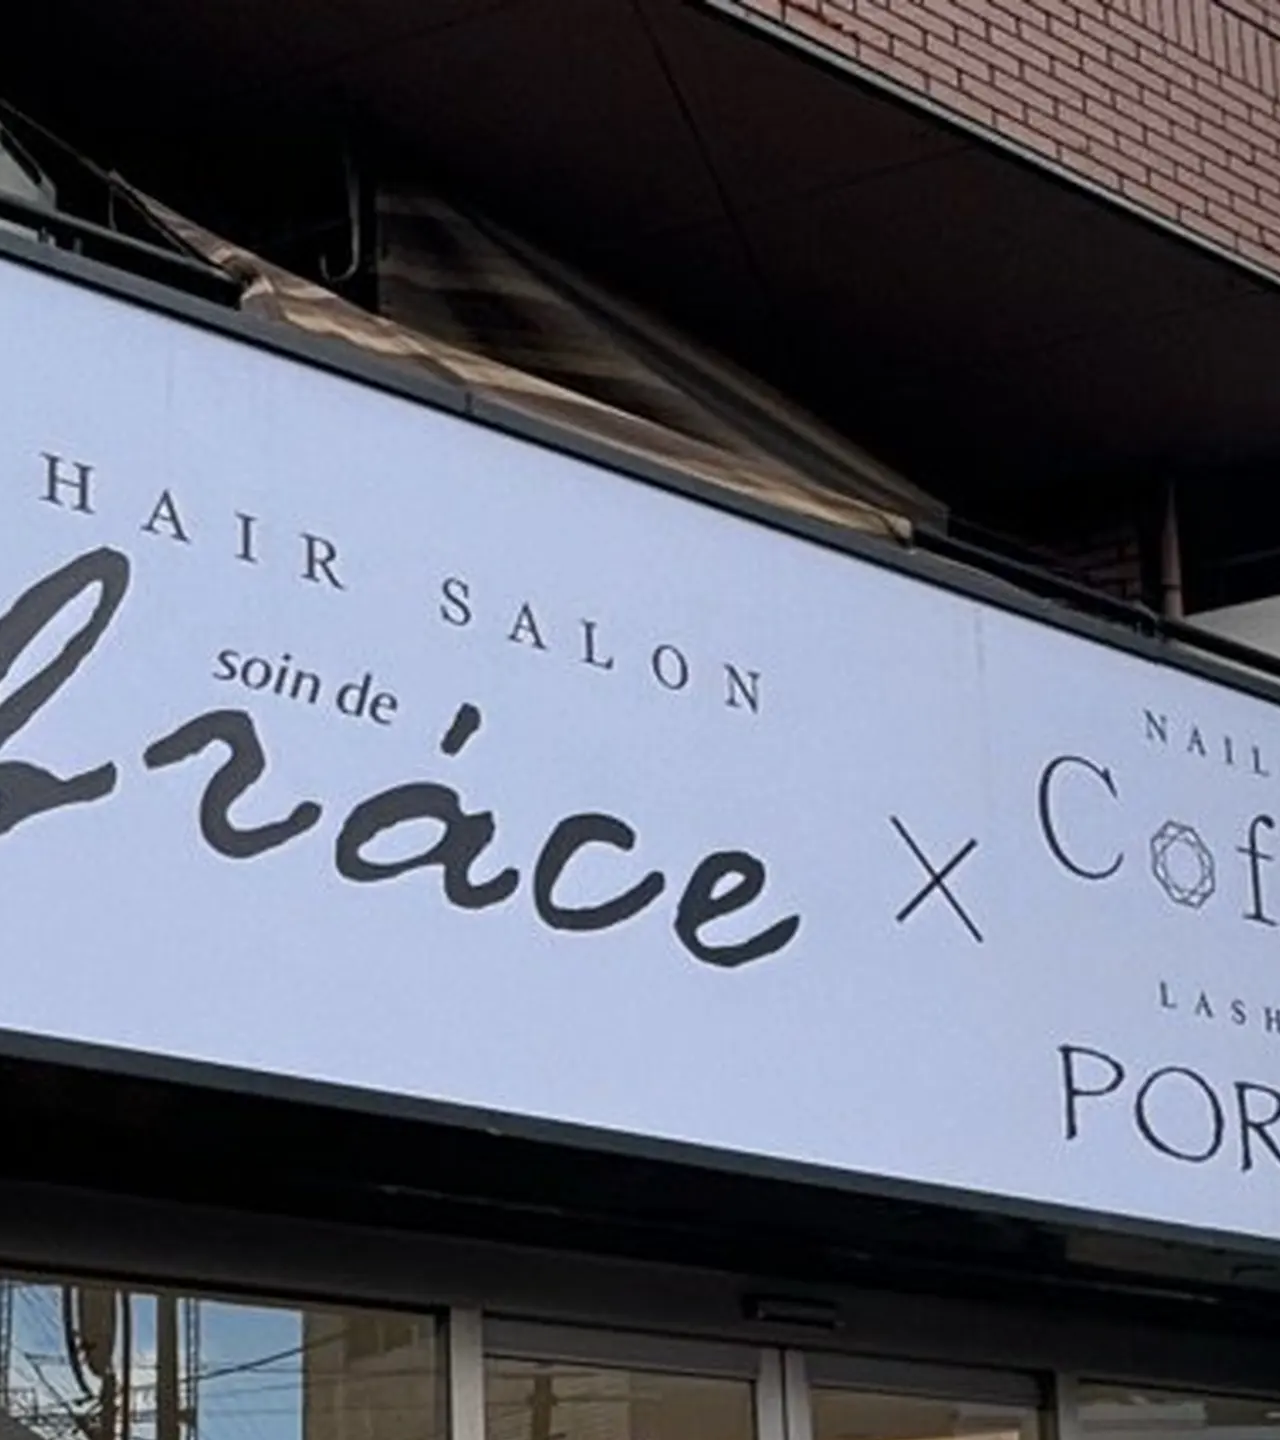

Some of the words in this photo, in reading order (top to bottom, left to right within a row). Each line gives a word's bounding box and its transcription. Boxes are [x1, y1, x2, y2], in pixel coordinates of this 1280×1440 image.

[39, 451, 346, 590] HAIR
[440, 576, 762, 714] SALON
[213, 645, 320, 707] soin
[335, 669, 398, 725] de
[1143, 709, 1270, 777] NAIL
